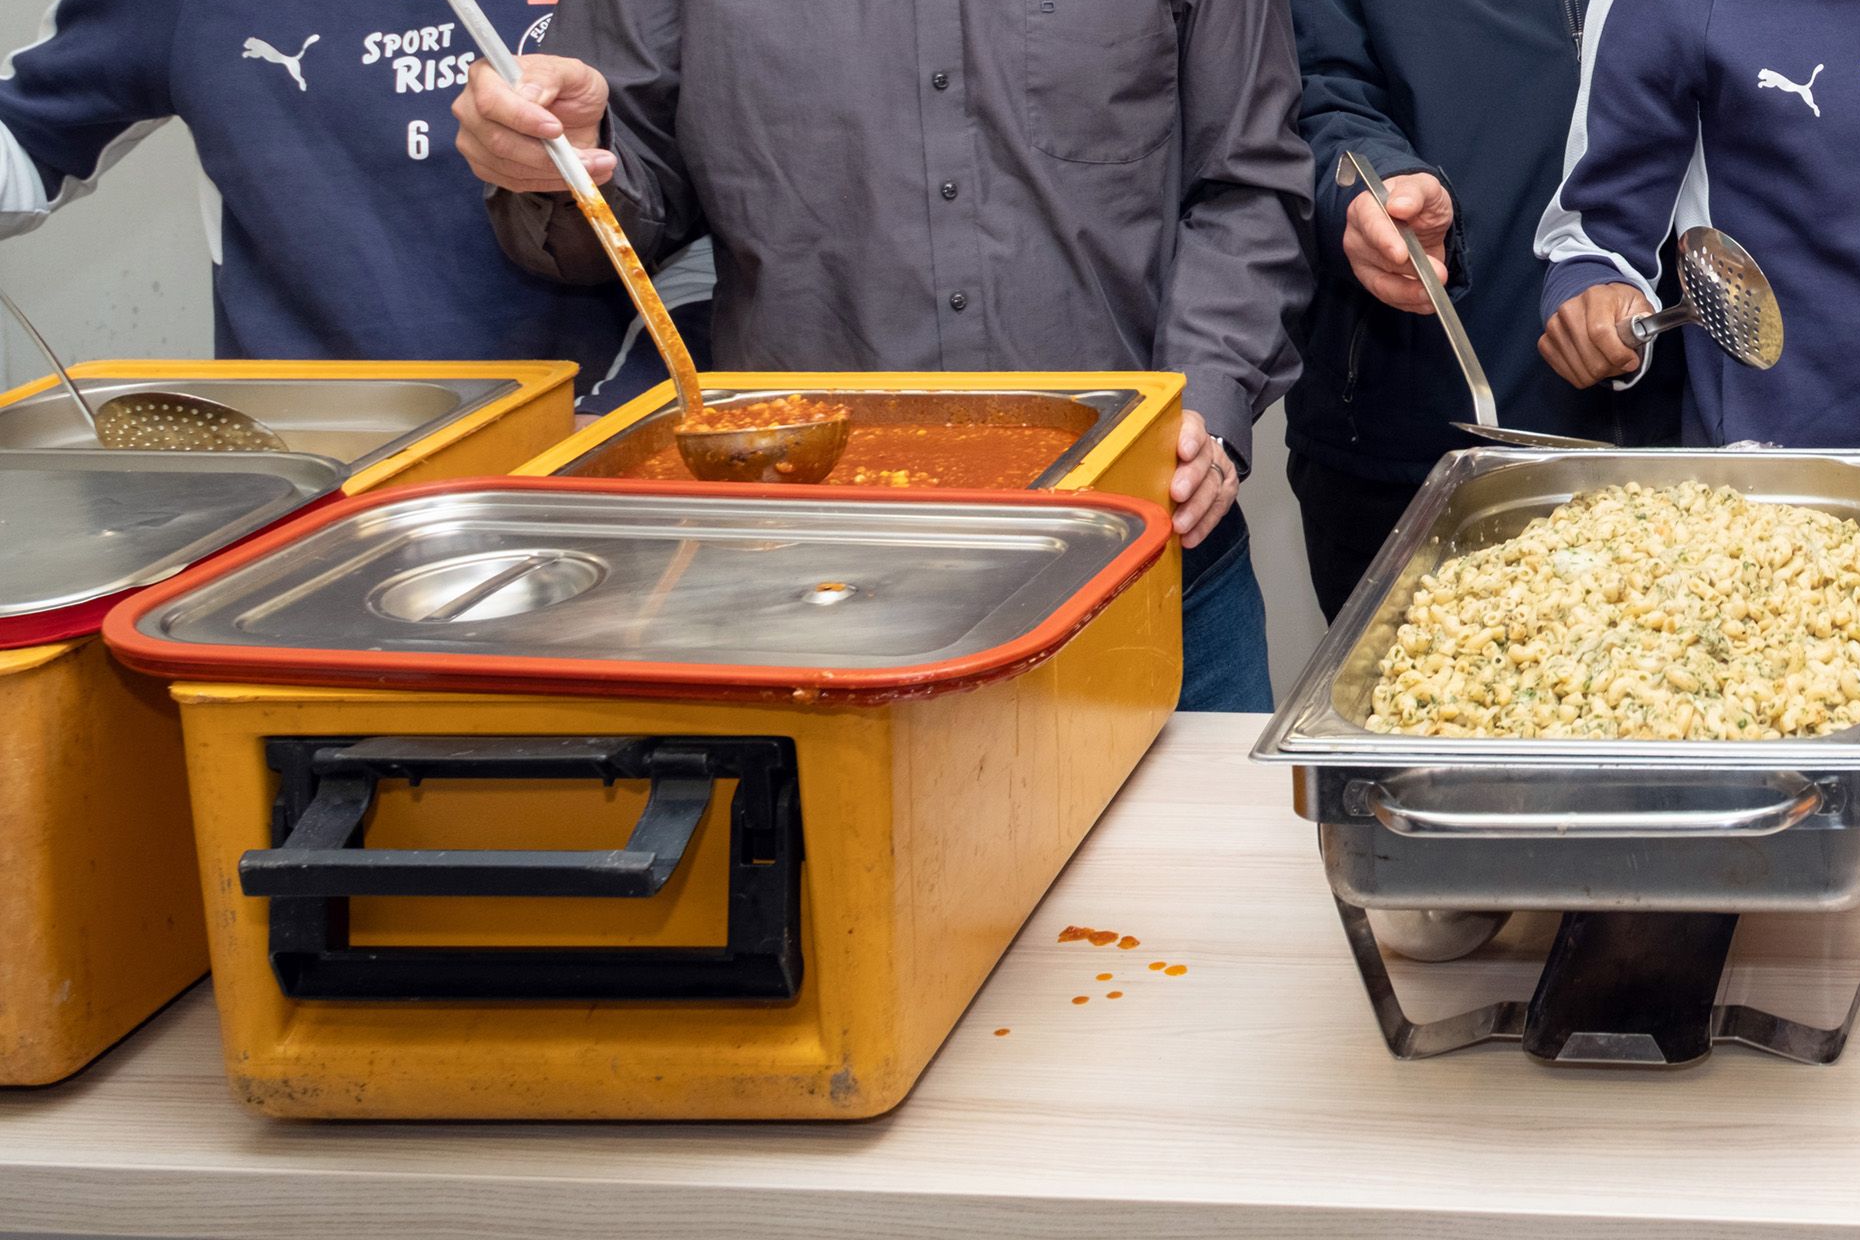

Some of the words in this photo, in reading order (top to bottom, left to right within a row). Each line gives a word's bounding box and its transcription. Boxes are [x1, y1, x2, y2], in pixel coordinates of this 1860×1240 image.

[362, 22, 455, 64] SPORT
[392, 52, 475, 93] RISS
[407, 120, 429, 160] 6
